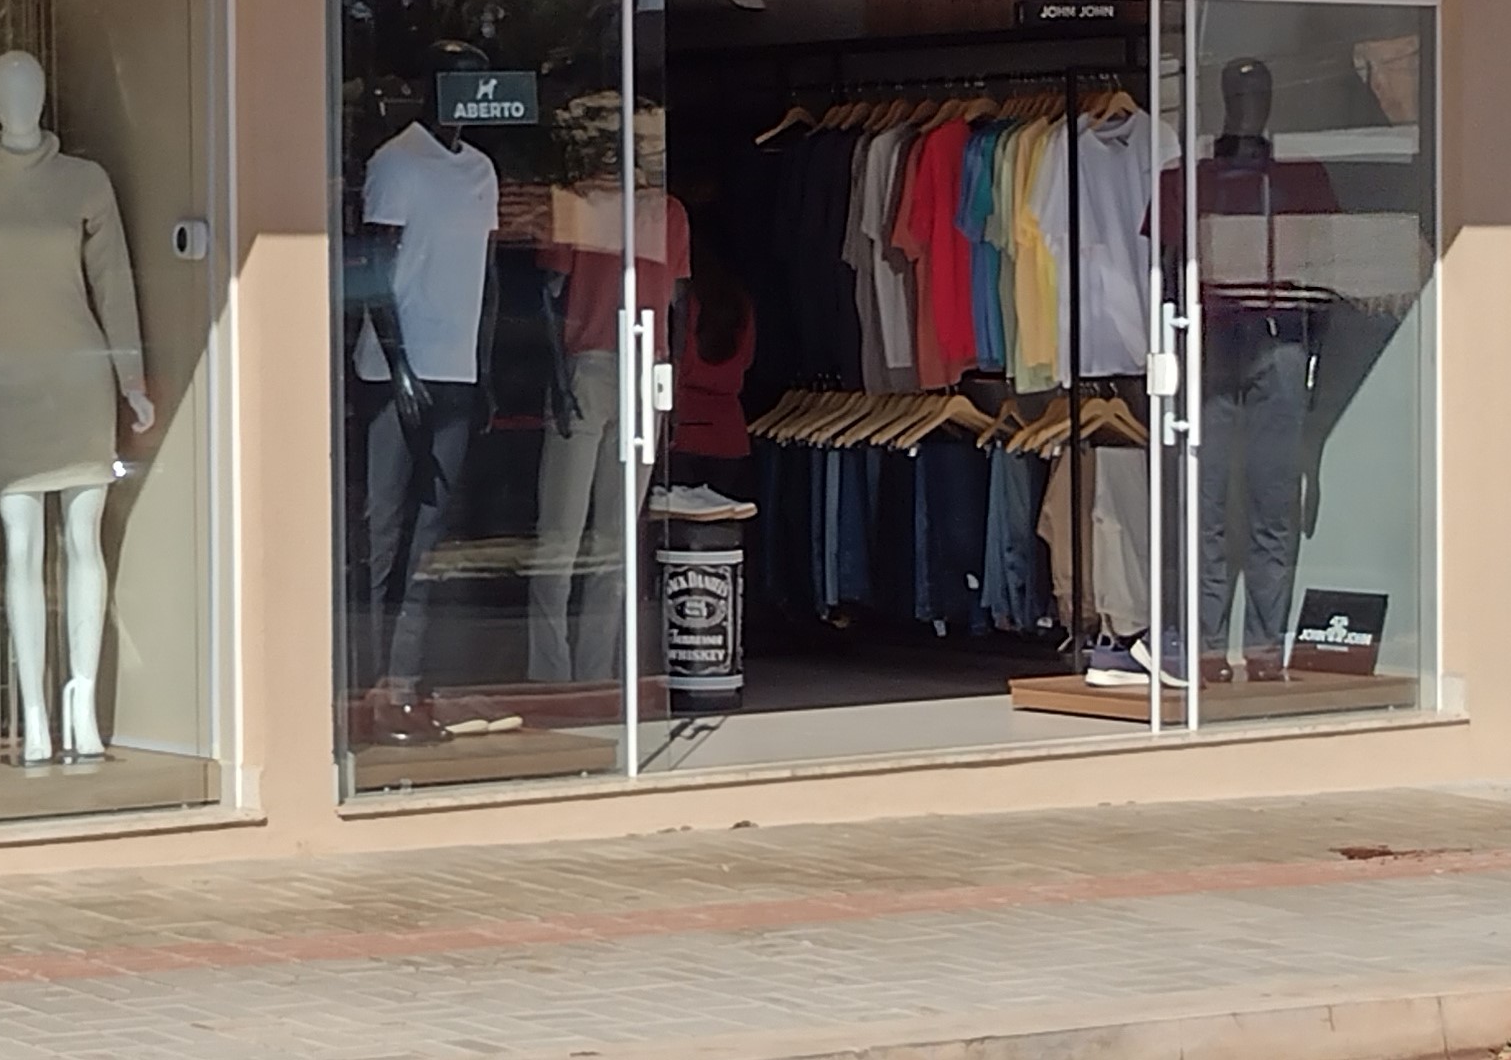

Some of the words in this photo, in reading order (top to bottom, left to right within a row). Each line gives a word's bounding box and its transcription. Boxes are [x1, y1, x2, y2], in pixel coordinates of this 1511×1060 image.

[1040, 5, 1076, 18] JOHN
[1079, 5, 1114, 18] JOHN
[454, 102, 525, 119] ABERTO
